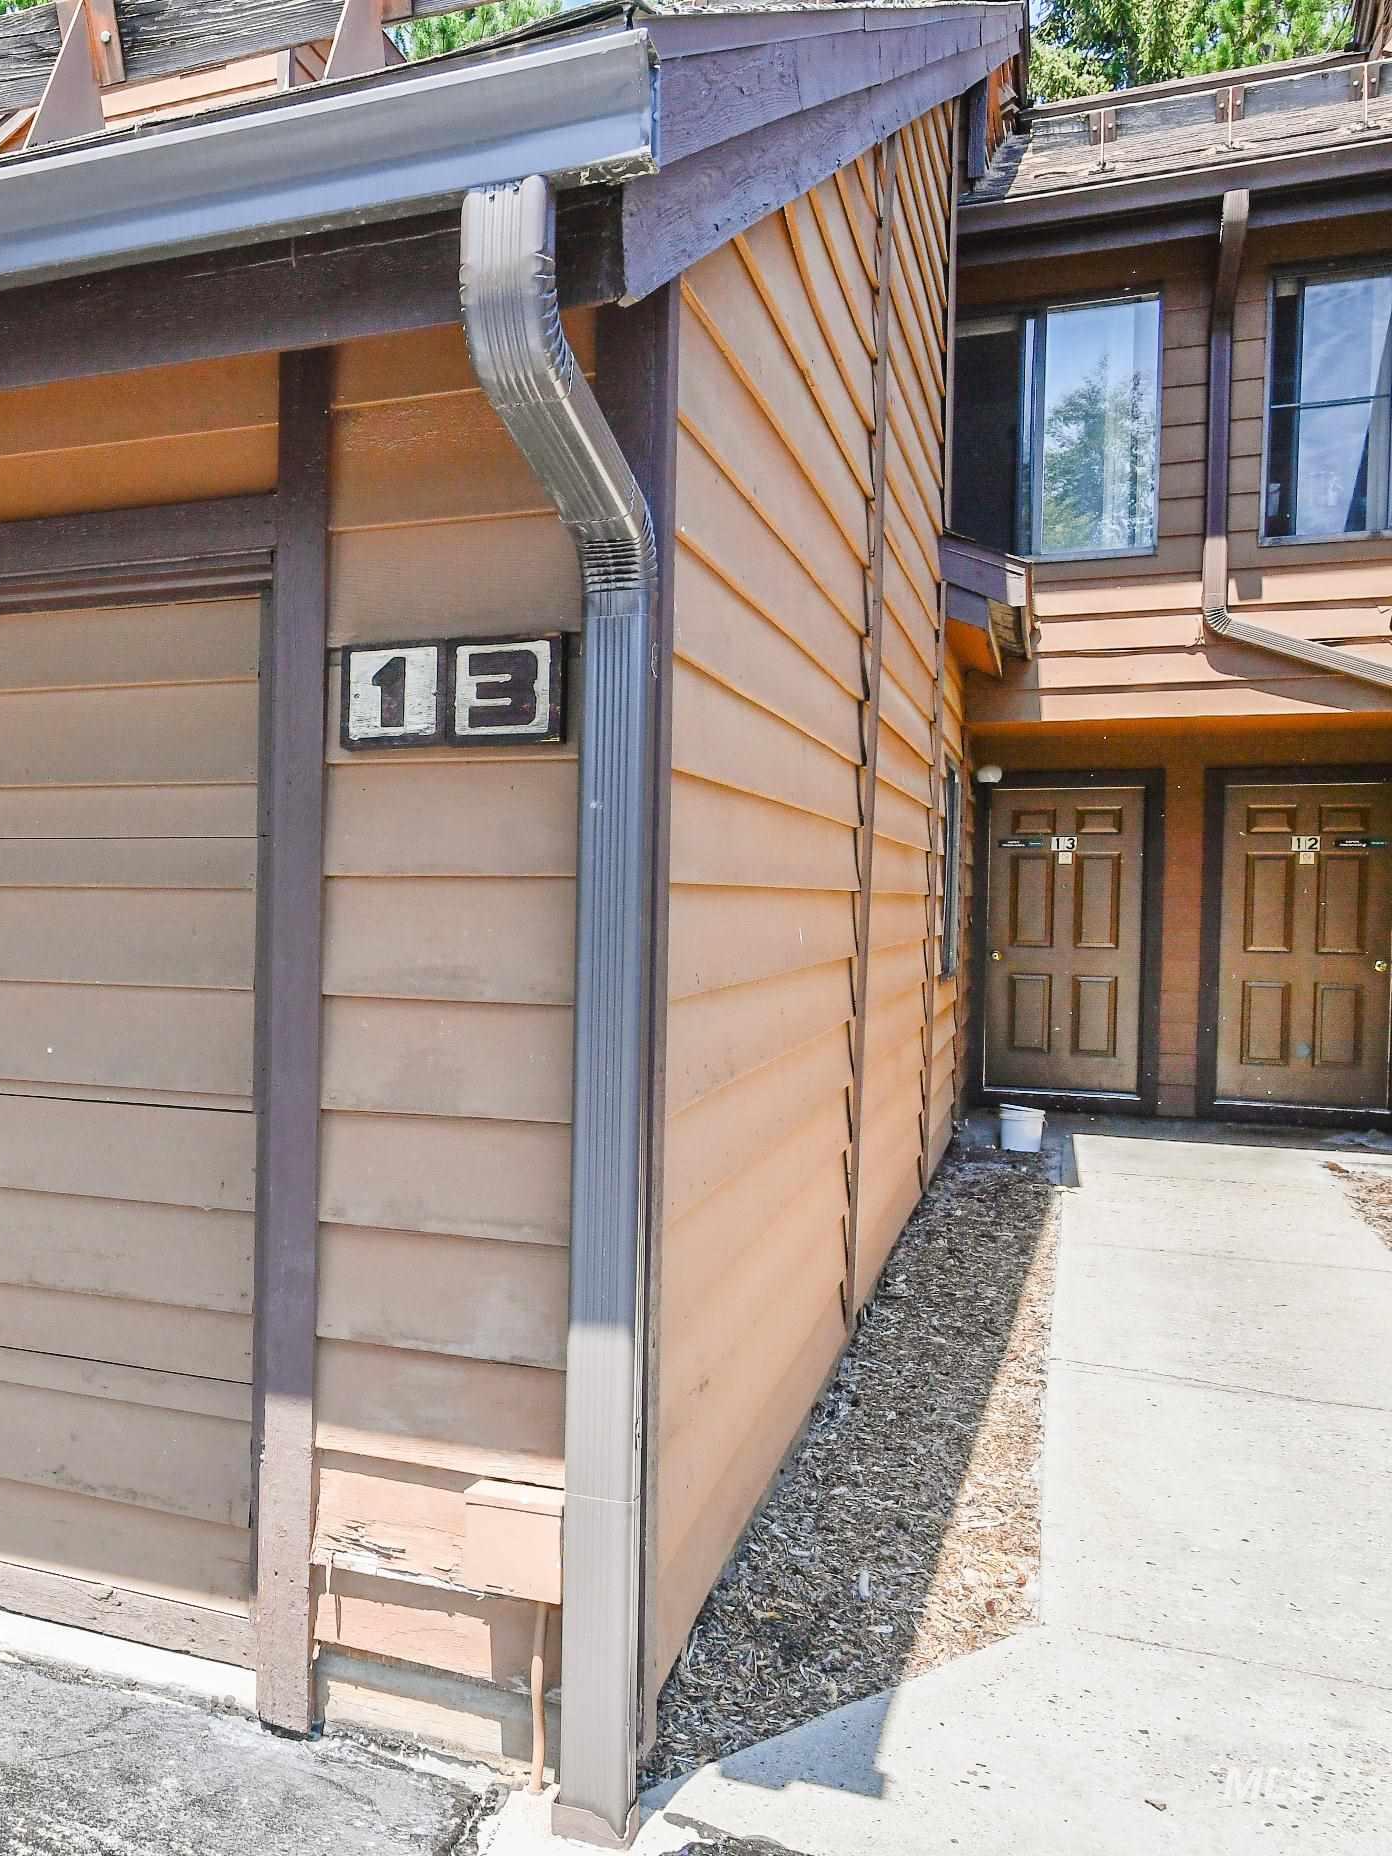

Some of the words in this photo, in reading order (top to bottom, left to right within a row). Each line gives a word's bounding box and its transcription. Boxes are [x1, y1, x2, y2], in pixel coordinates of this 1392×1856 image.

[371, 649, 539, 729] 13
[1055, 837, 1076, 850] 13
[1296, 837, 1319, 850] 12
